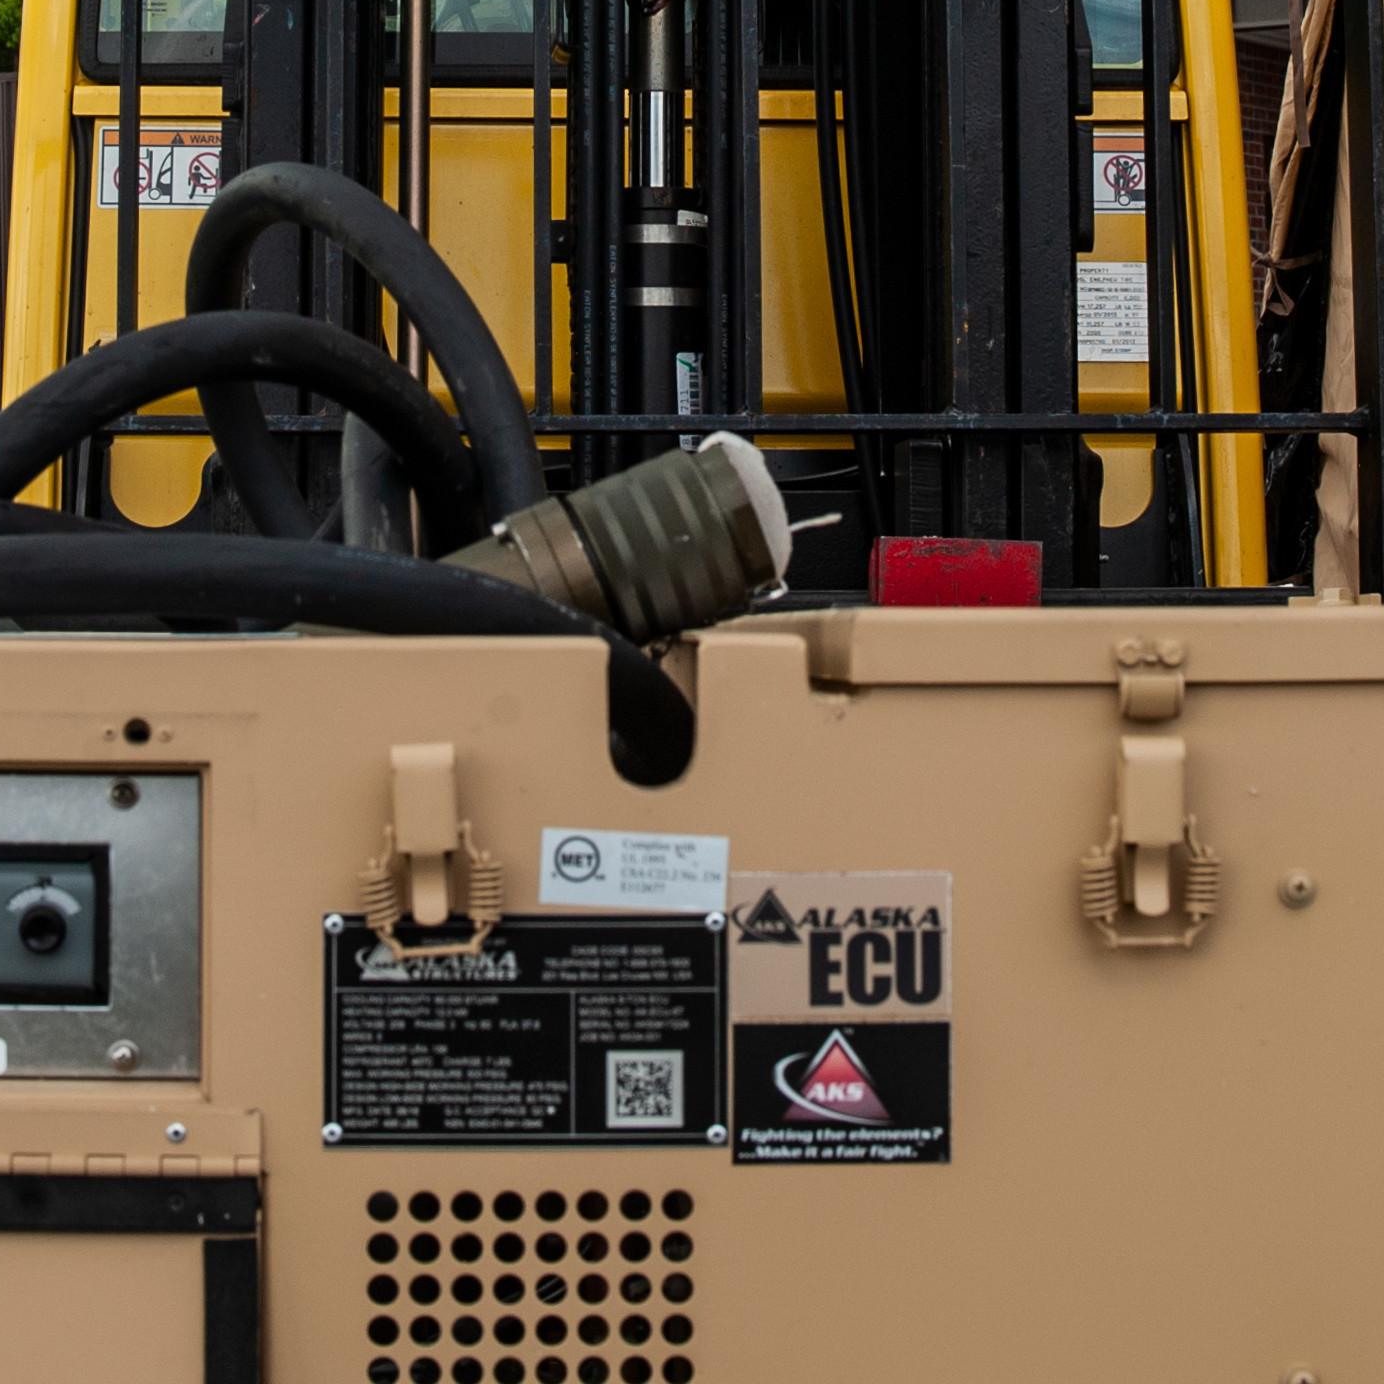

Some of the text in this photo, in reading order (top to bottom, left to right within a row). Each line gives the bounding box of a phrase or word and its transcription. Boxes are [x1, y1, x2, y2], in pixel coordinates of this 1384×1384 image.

[609, 245, 617, 273] EATON
[584, 290, 592, 319] EATON
[609, 278, 617, 316] SYNFLEX
[680, 390, 689, 412] 711
[561, 853, 594, 867] MET
[797, 906, 942, 928] ALASKA
[412, 969, 517, 981] STRUCTURES
[810, 930, 942, 1007] ECU
[806, 1082, 865, 1102] AKS
[741, 1126, 944, 1143] Fighting the elements?
[805, 1145, 817, 1158] it
[821, 1148, 833, 1159] a
[836, 1145, 867, 1158] fair
